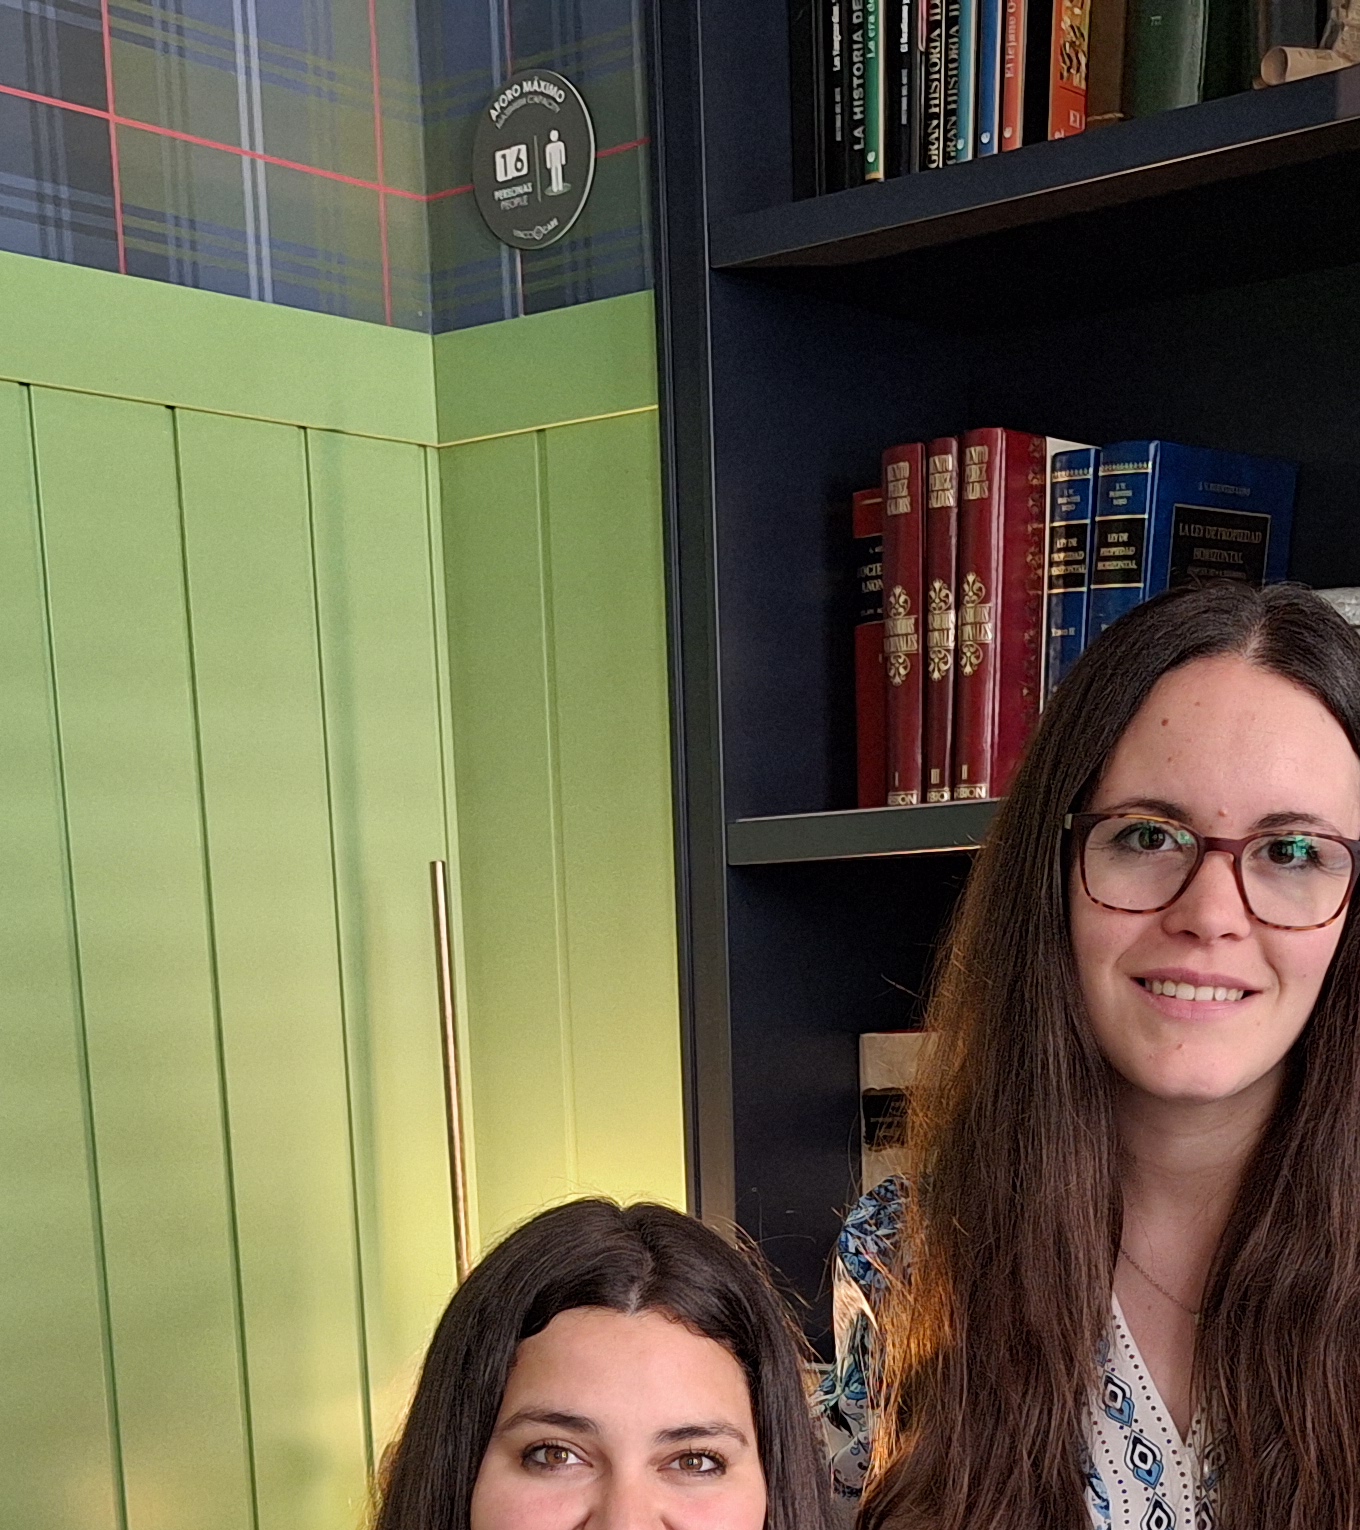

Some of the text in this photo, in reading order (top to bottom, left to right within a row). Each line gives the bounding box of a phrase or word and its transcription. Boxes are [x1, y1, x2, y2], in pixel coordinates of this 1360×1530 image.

[853, 29, 864, 120] HISTORIA
[928, 28, 941, 114] HISTORIA
[489, 75, 566, 122] AFORO MÁXIMO
[853, 126, 865, 150] LA
[926, 120, 939, 168] GRAN
[501, 147, 525, 177] 16
[493, 182, 533, 201] PERSONAS
[1179, 523, 1263, 544] LA LEY DE PROPIEDAD
[1193, 547, 1244, 564] HORIZONTAL
